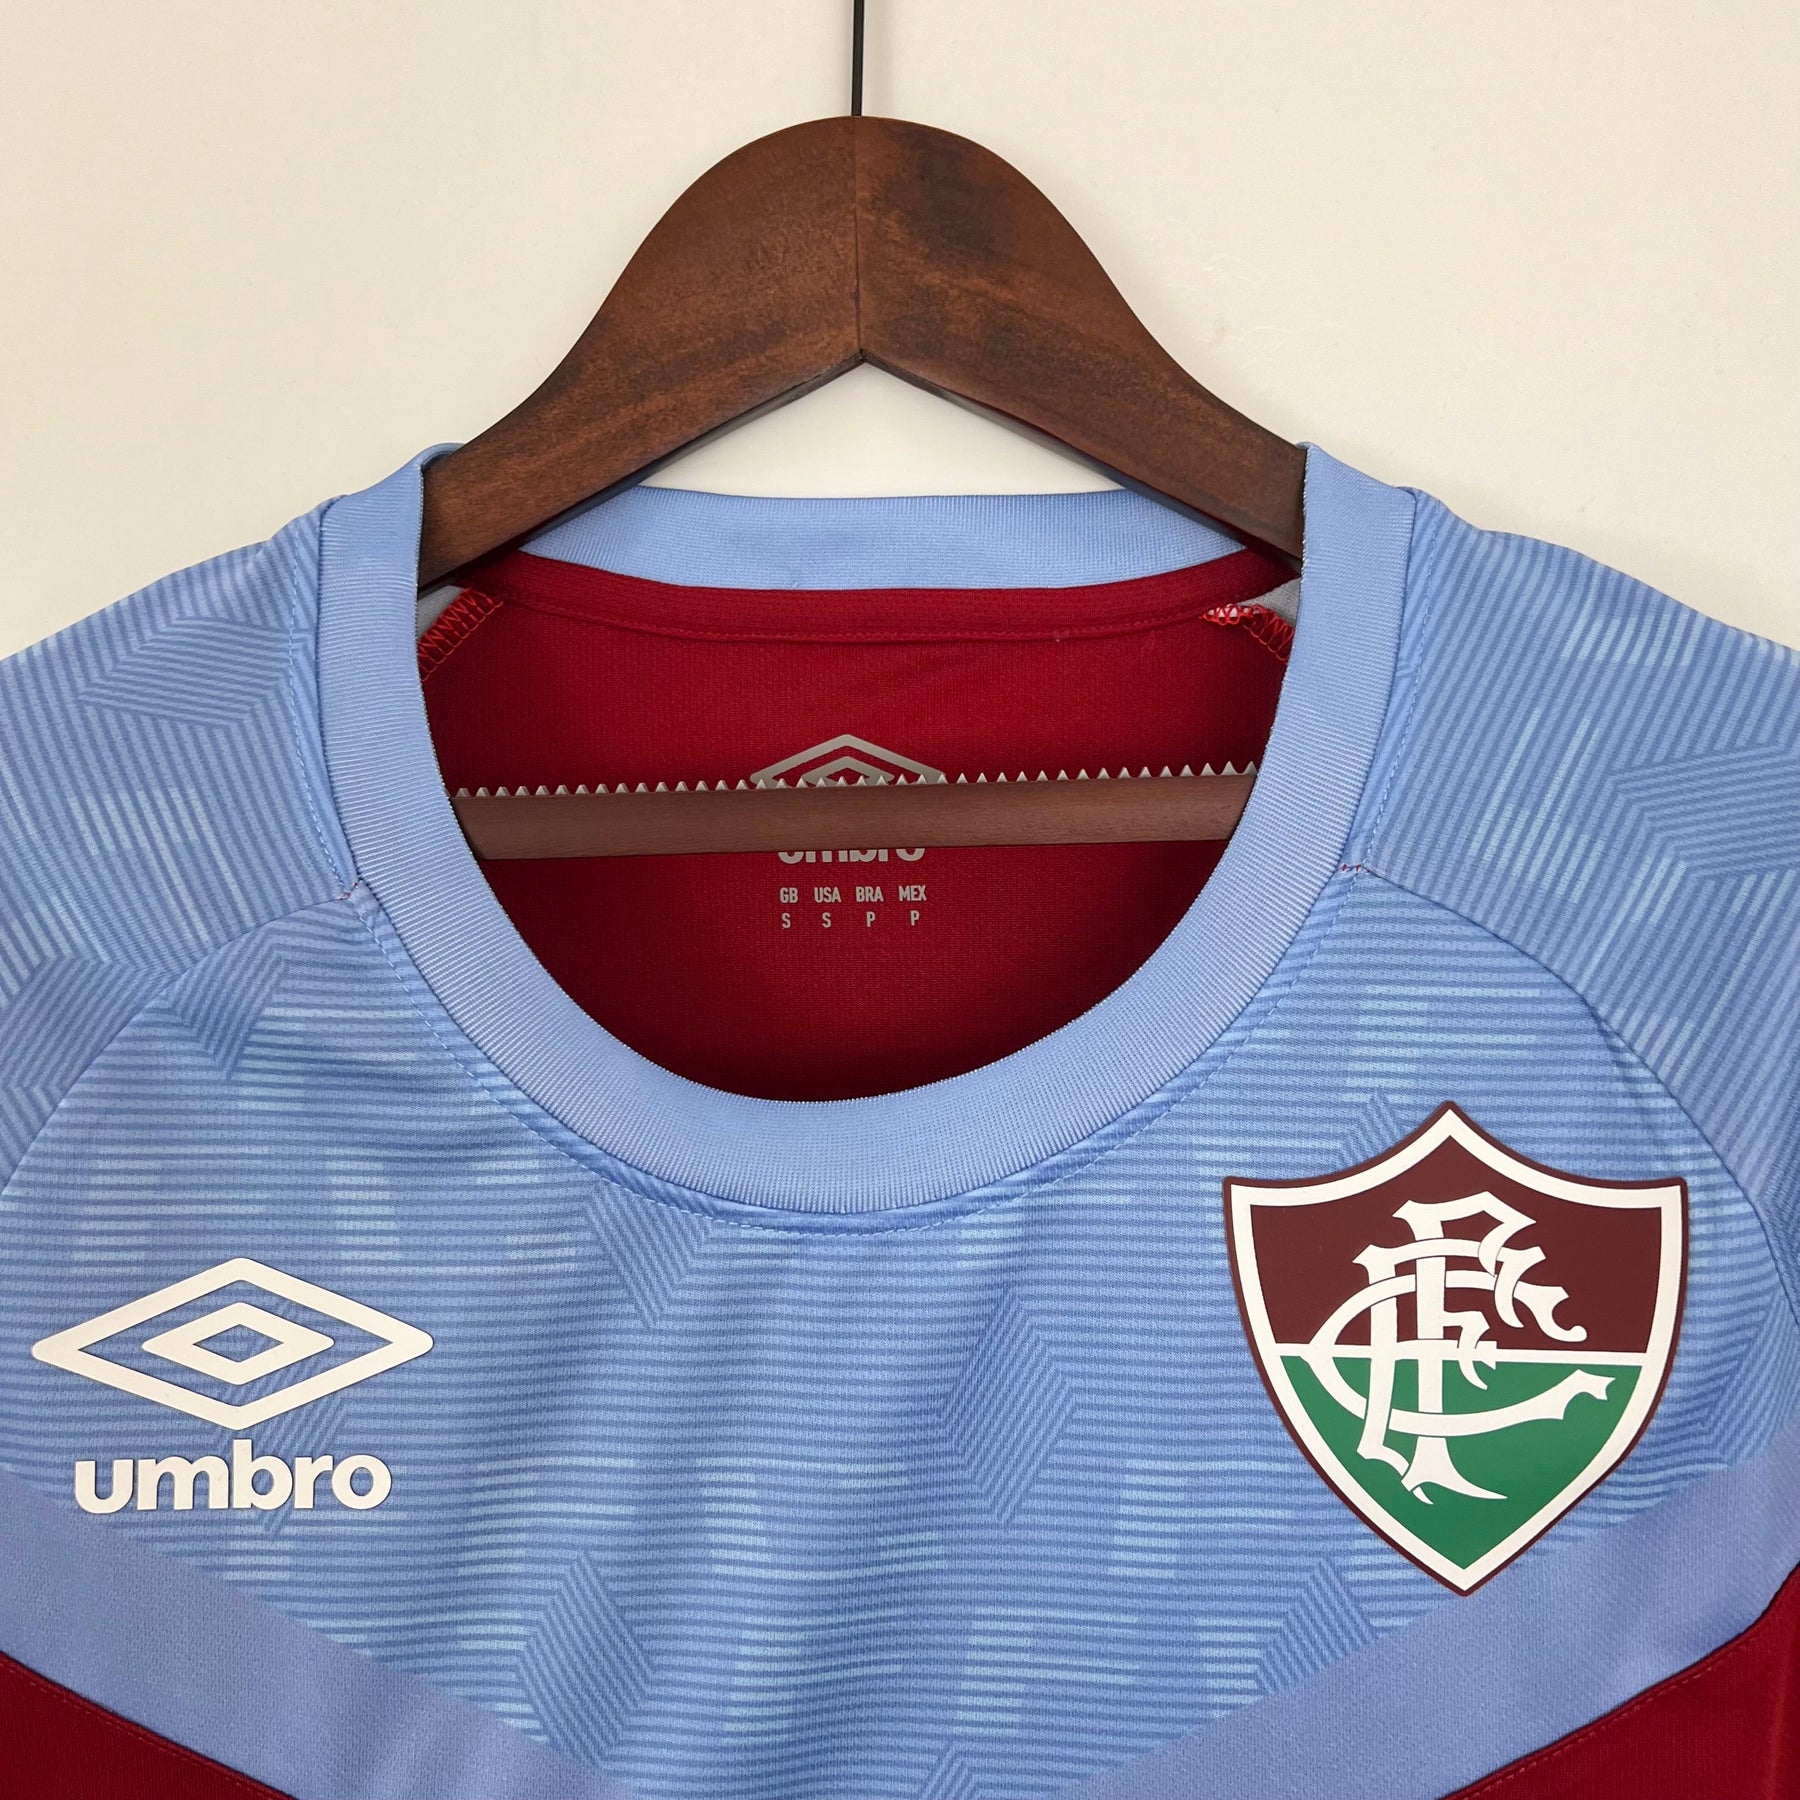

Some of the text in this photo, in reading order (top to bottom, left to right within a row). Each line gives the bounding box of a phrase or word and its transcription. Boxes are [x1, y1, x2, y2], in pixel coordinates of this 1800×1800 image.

[779, 884, 927, 904] GB USA BRA MEX
[781, 910, 920, 929] S S P P
[75, 1438, 392, 1514] umbro
